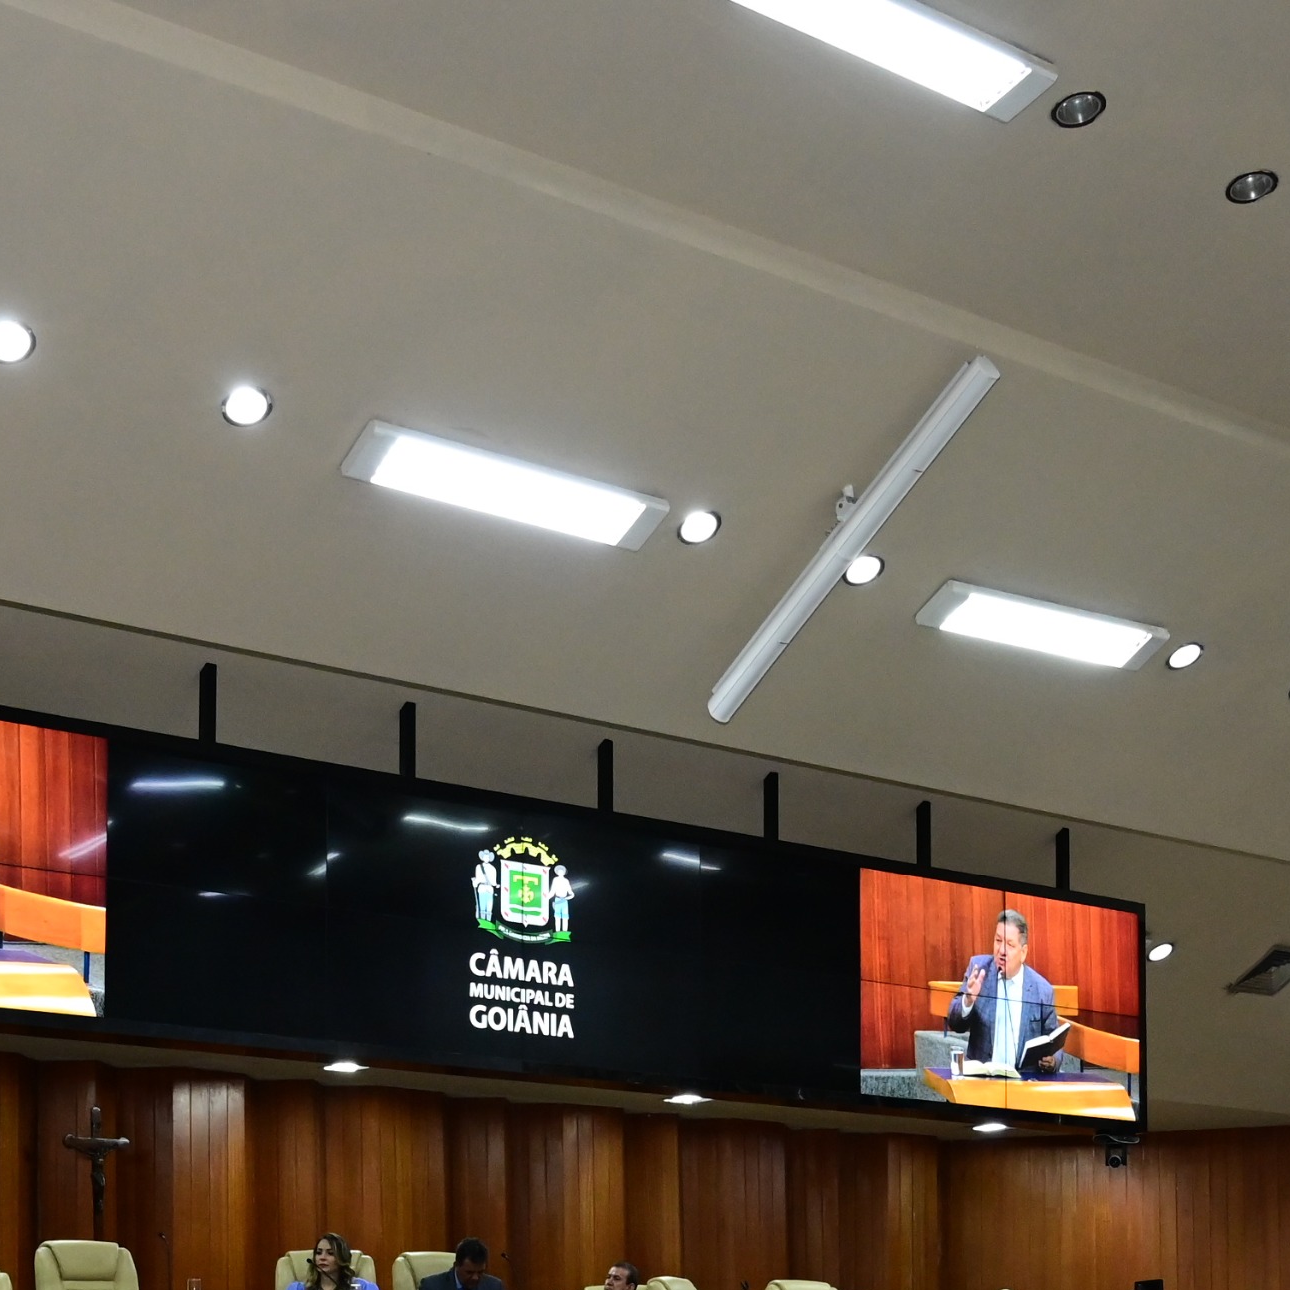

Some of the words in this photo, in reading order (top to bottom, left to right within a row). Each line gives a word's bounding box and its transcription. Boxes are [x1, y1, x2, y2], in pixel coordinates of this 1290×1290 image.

[469, 948, 574, 987] CÂMARA
[469, 982, 553, 1007] MUNICIPAL
[554, 992, 575, 1009] DE
[469, 1004, 575, 1039] GOIÂNIA
